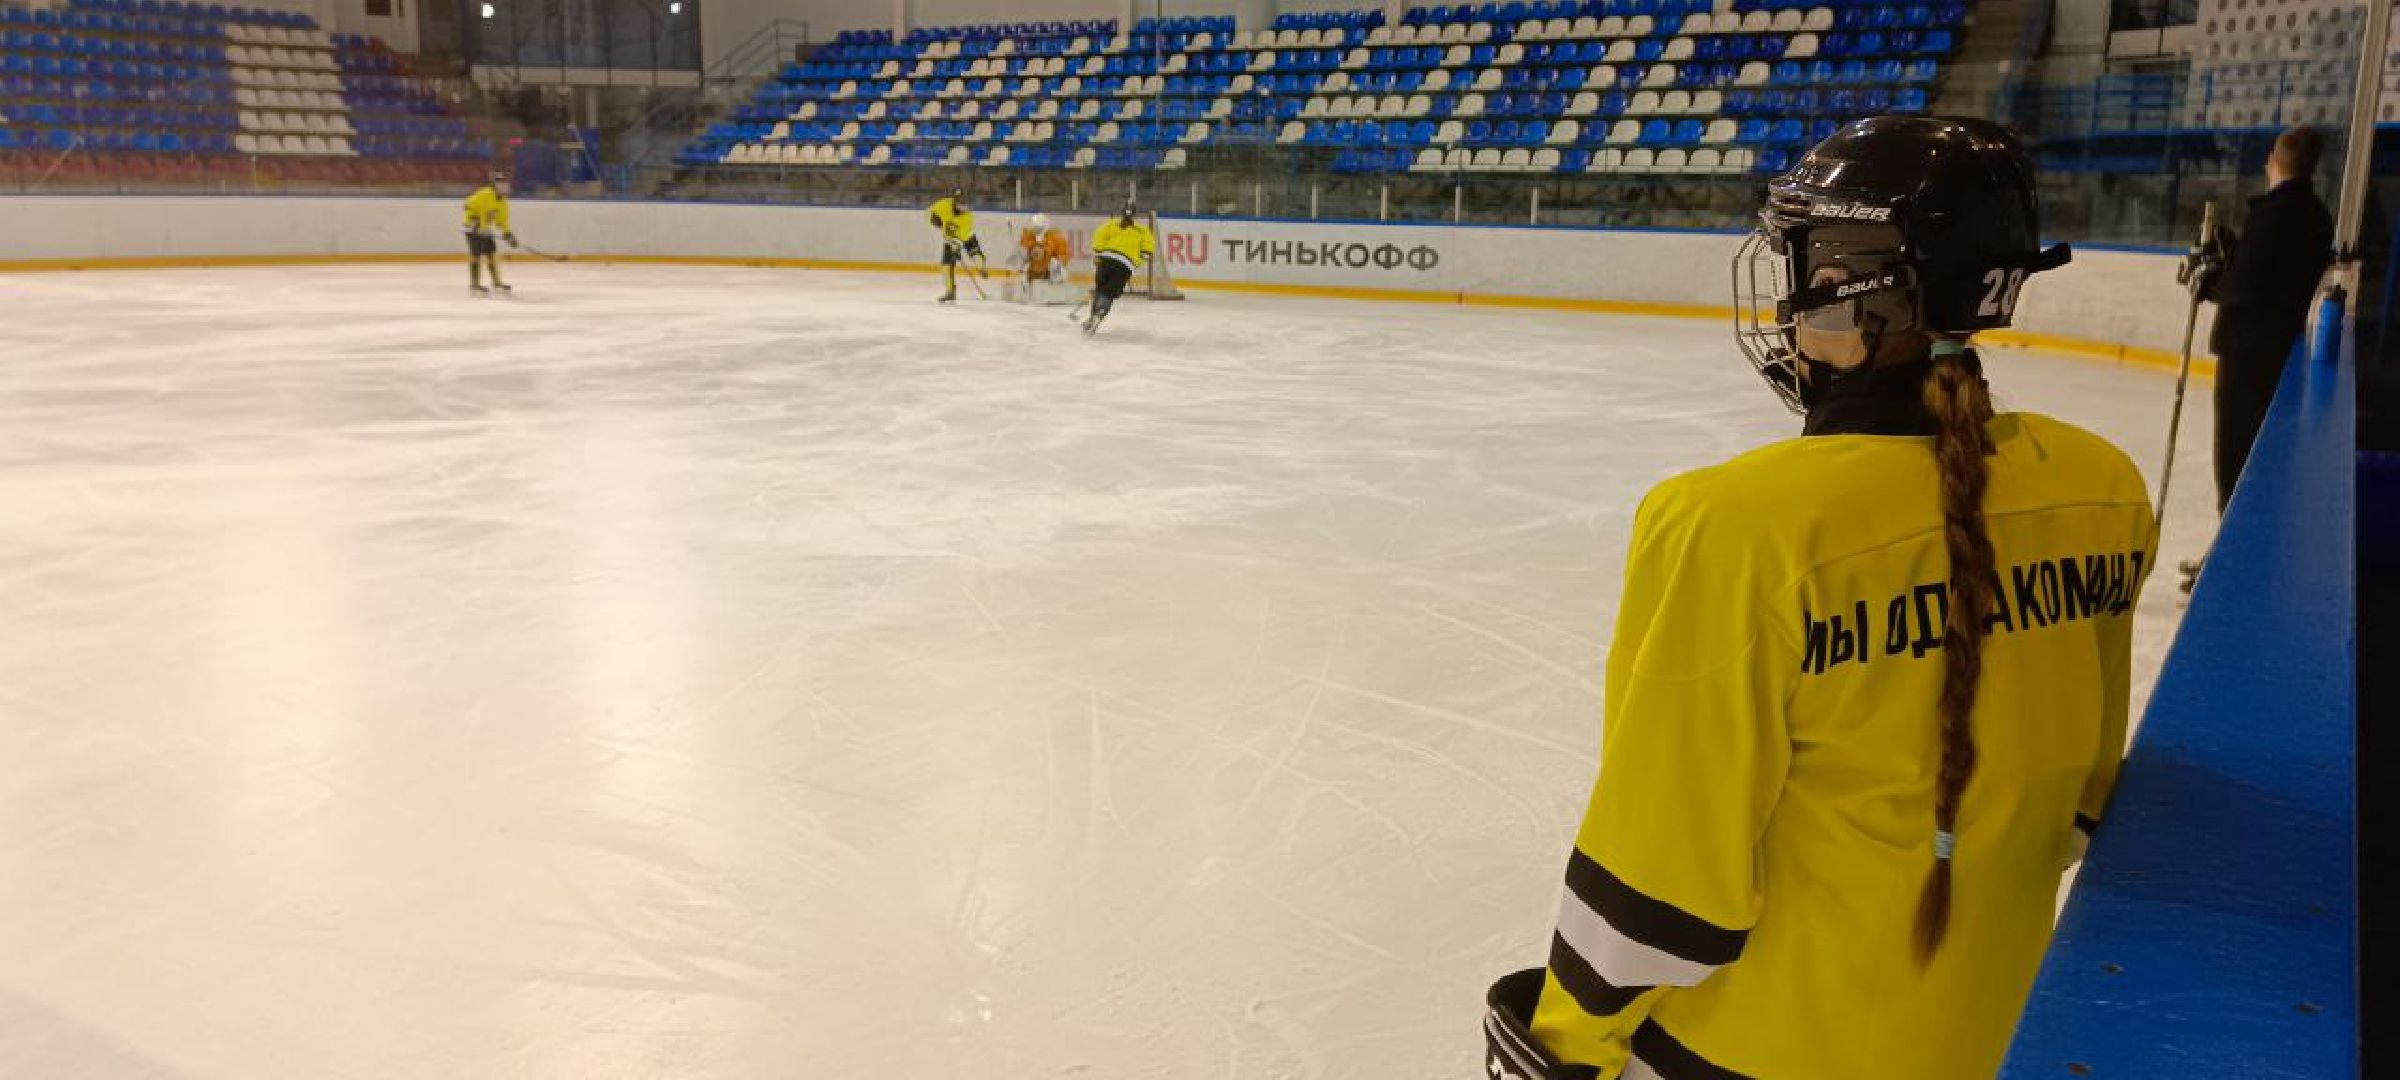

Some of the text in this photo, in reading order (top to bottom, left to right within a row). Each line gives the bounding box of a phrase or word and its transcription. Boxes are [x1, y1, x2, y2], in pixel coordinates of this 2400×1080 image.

[1810, 203, 1892, 221] BAUER
[1221, 238, 1440, 271] ТИНЬКОФФ
[1977, 267, 2024, 317] 28
[1885, 568, 2014, 659] ОДА
[2011, 550, 2145, 631] КОМАНД
